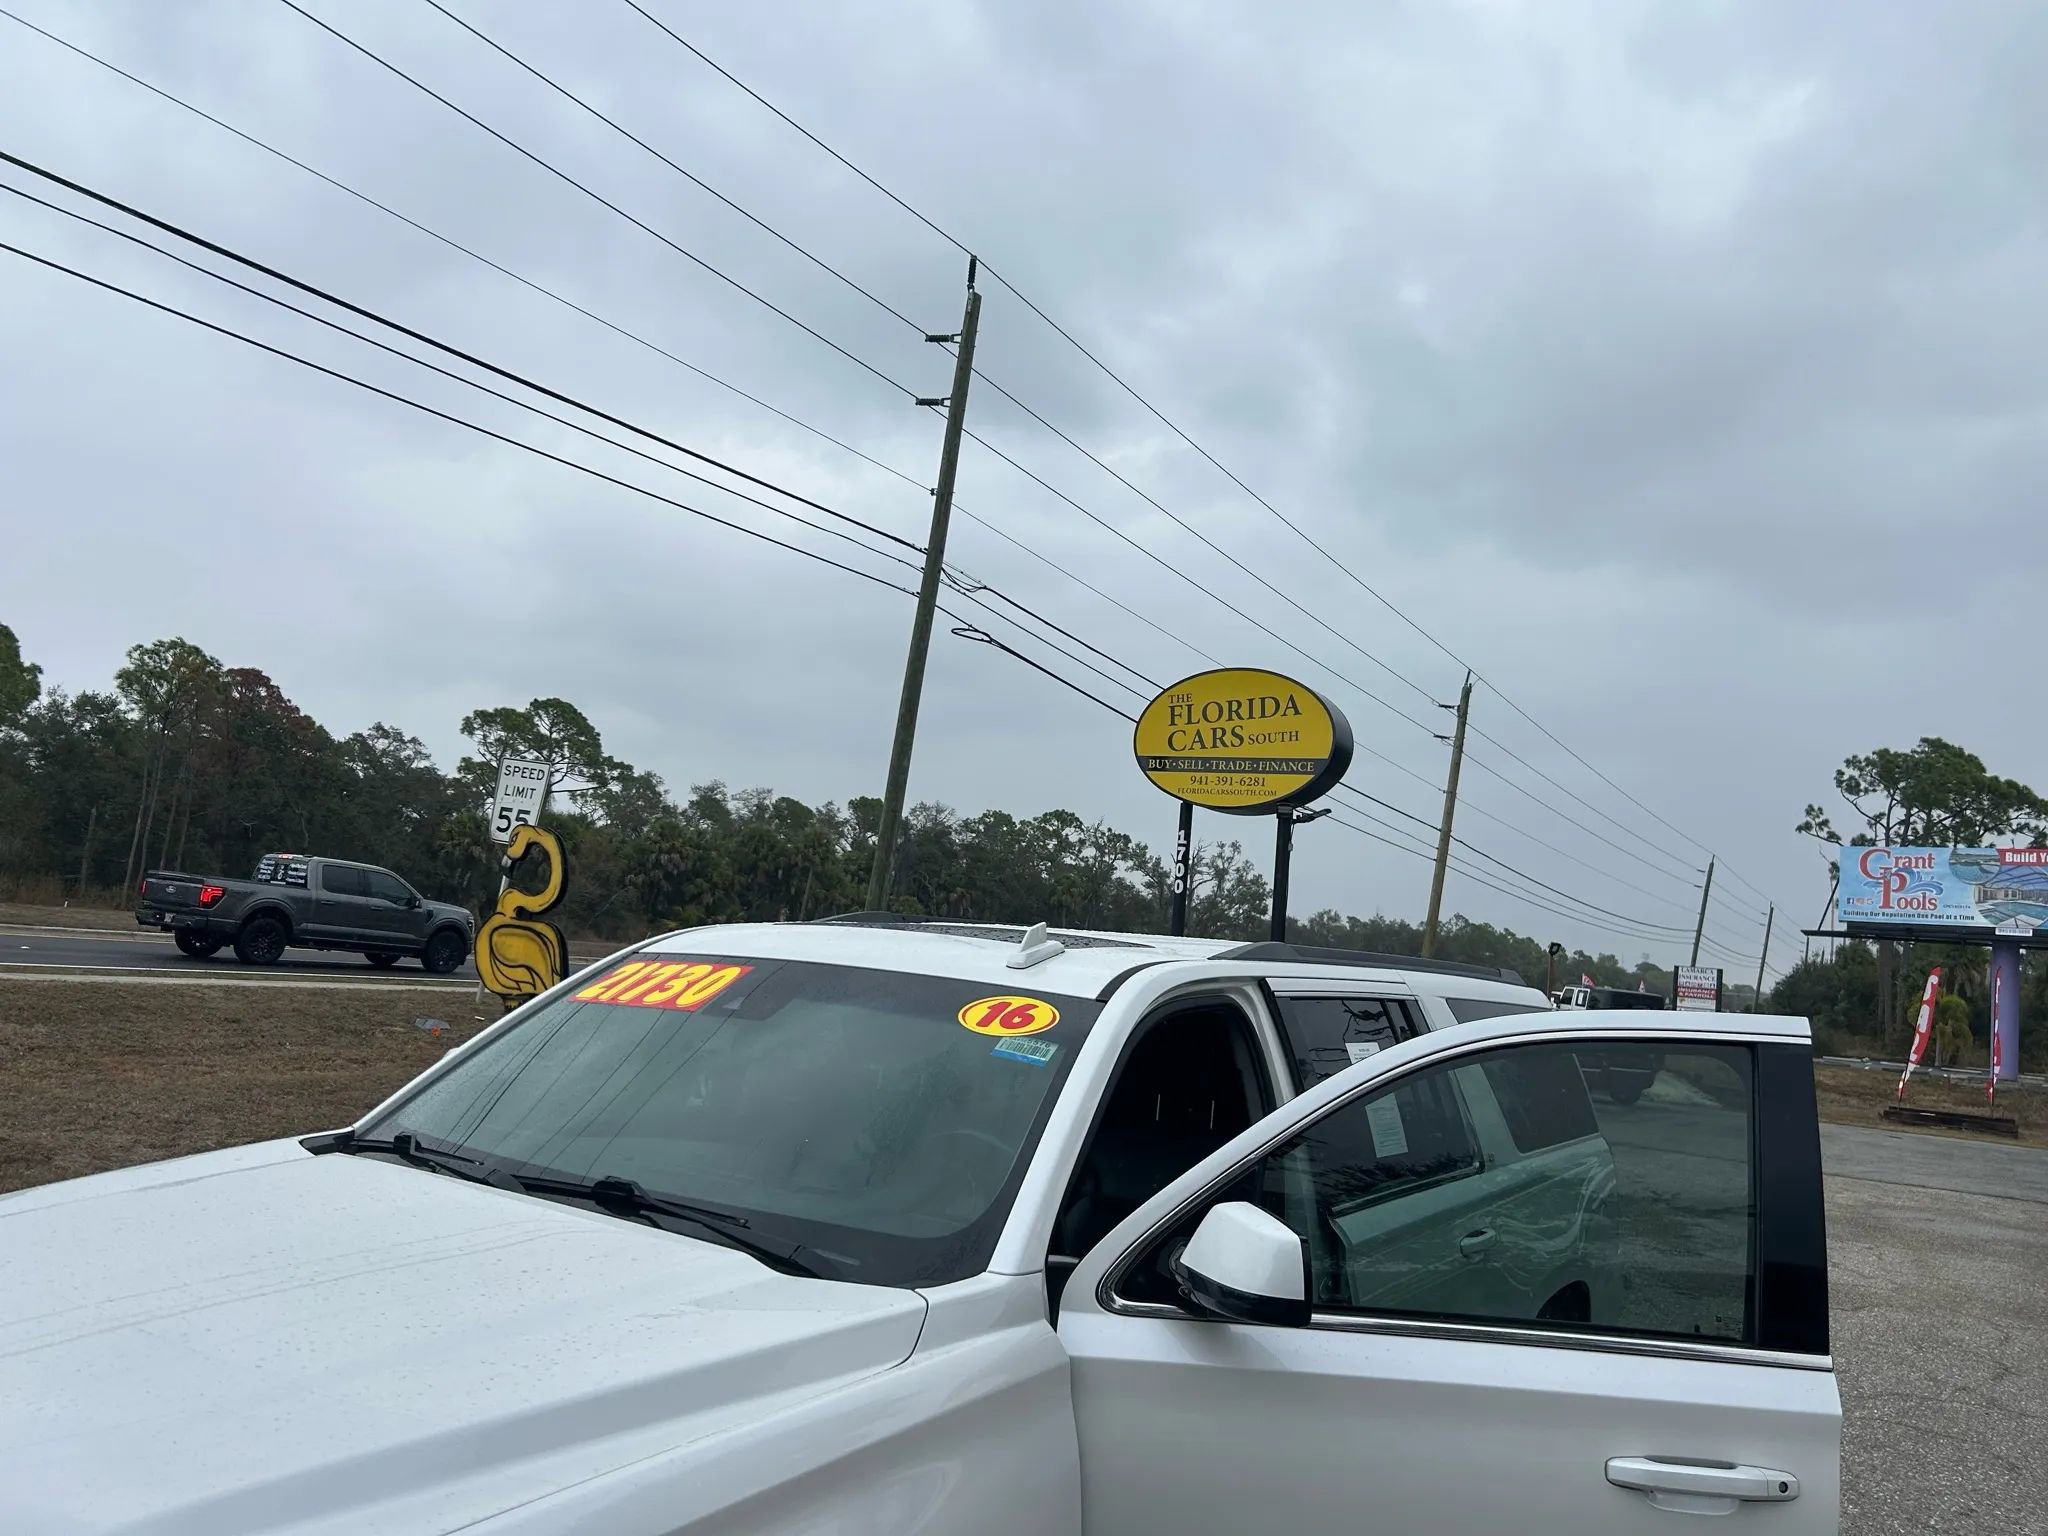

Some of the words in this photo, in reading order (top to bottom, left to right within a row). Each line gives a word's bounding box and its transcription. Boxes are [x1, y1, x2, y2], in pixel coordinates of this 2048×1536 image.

[1168, 693, 1192, 703] THE
[1168, 694, 1303, 726] FLORIDA
[1167, 725, 1245, 752] CARS
[1248, 730, 1300, 745] SOUTH
[503, 765, 545, 781] SPEED
[1259, 761, 1315, 772] FINANCE
[1190, 775, 1266, 787] 941-391-6281
[504, 785, 537, 799] LIMIT
[1177, 788, 1277, 797] FLORIDACARSSOUTH.COM
[1174, 829, 1188, 894] 1700
[1860, 848, 1935, 880] Grant
[2005, 852, 2037, 863] Build
[1878, 867, 1938, 911] Pools
[575, 962, 741, 1007] 21730
[976, 1001, 1040, 1030] 16
